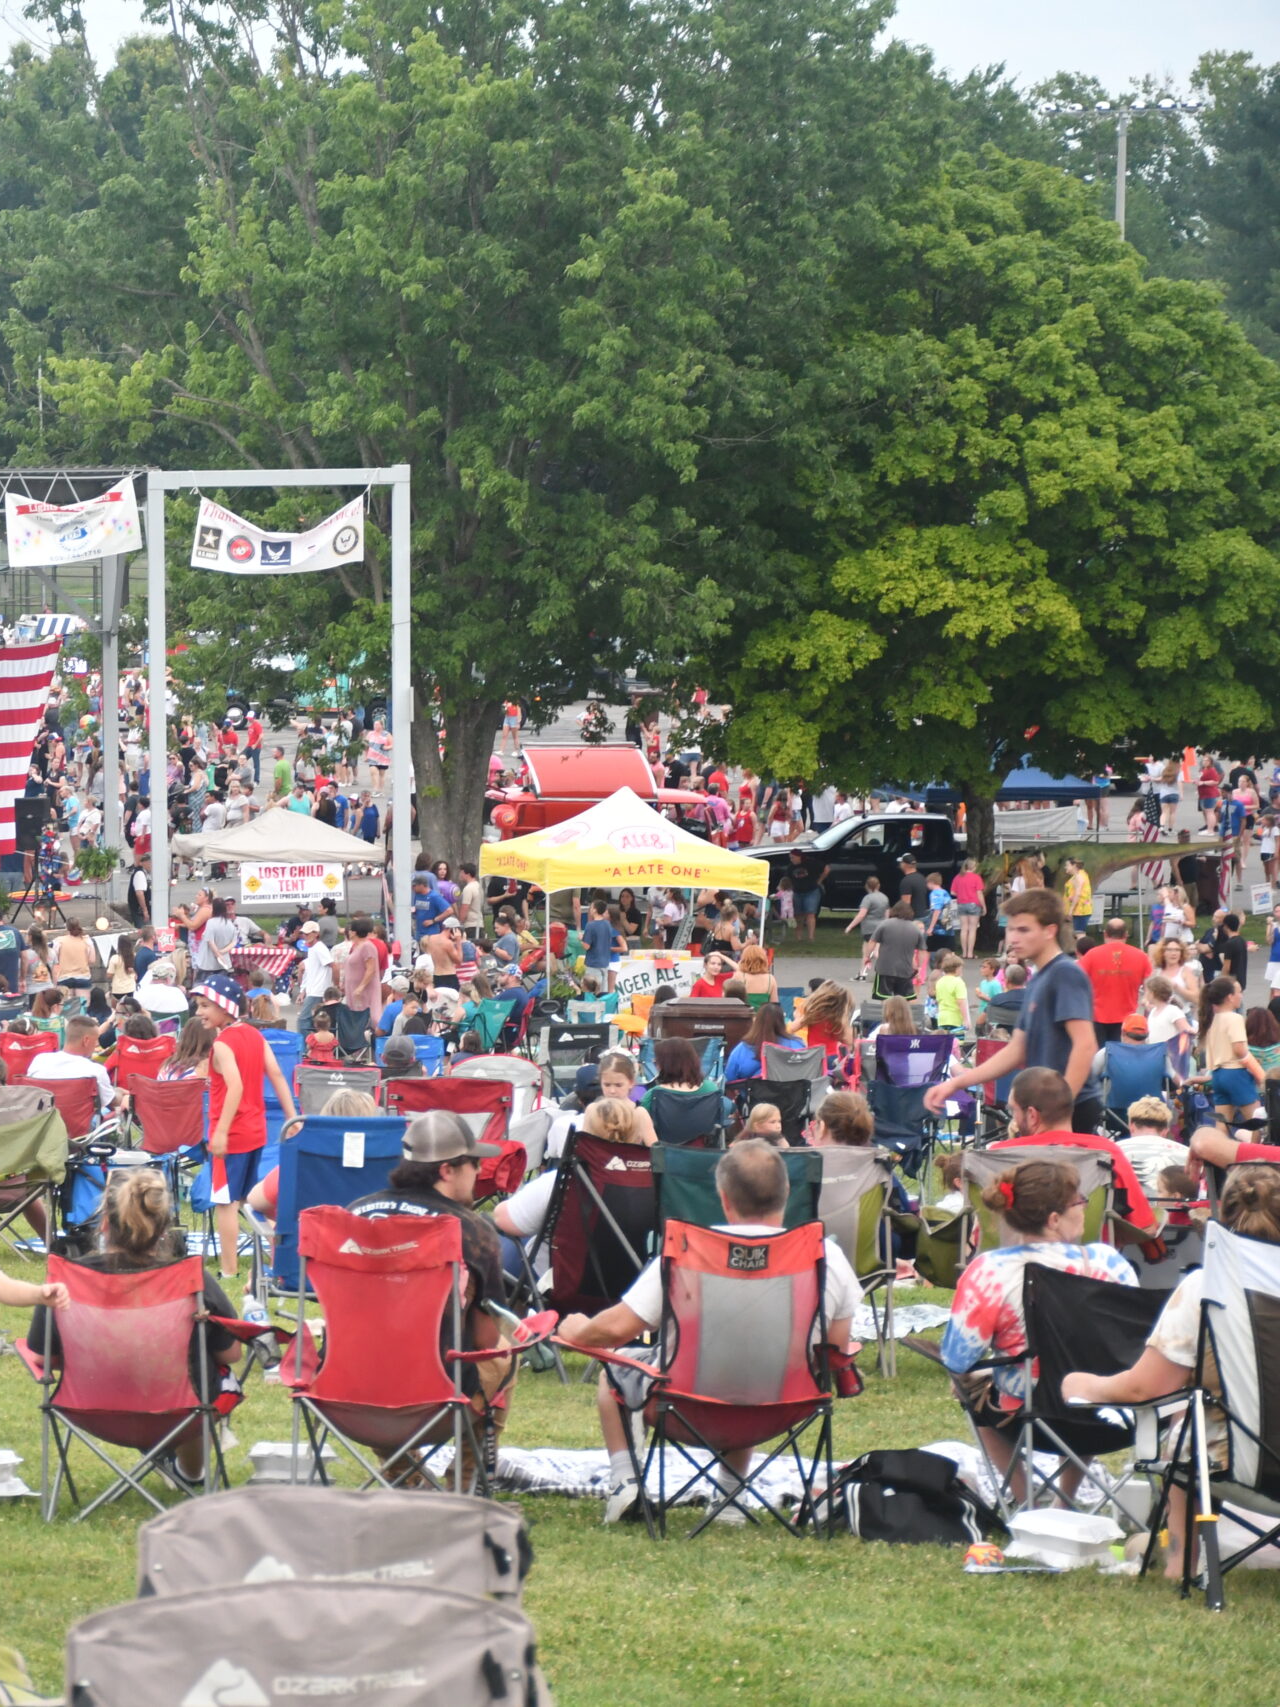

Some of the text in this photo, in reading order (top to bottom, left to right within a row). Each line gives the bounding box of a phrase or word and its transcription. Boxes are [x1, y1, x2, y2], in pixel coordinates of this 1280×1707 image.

[258, 864, 324, 879] LOST CHILD
[627, 864, 665, 876] LATE
[278, 879, 306, 892] TENT
[615, 972, 652, 996] NGER
[656, 962, 683, 985] ALE
[732, 1246, 766, 1260] QUIK
[730, 1257, 766, 1268] CHAIR
